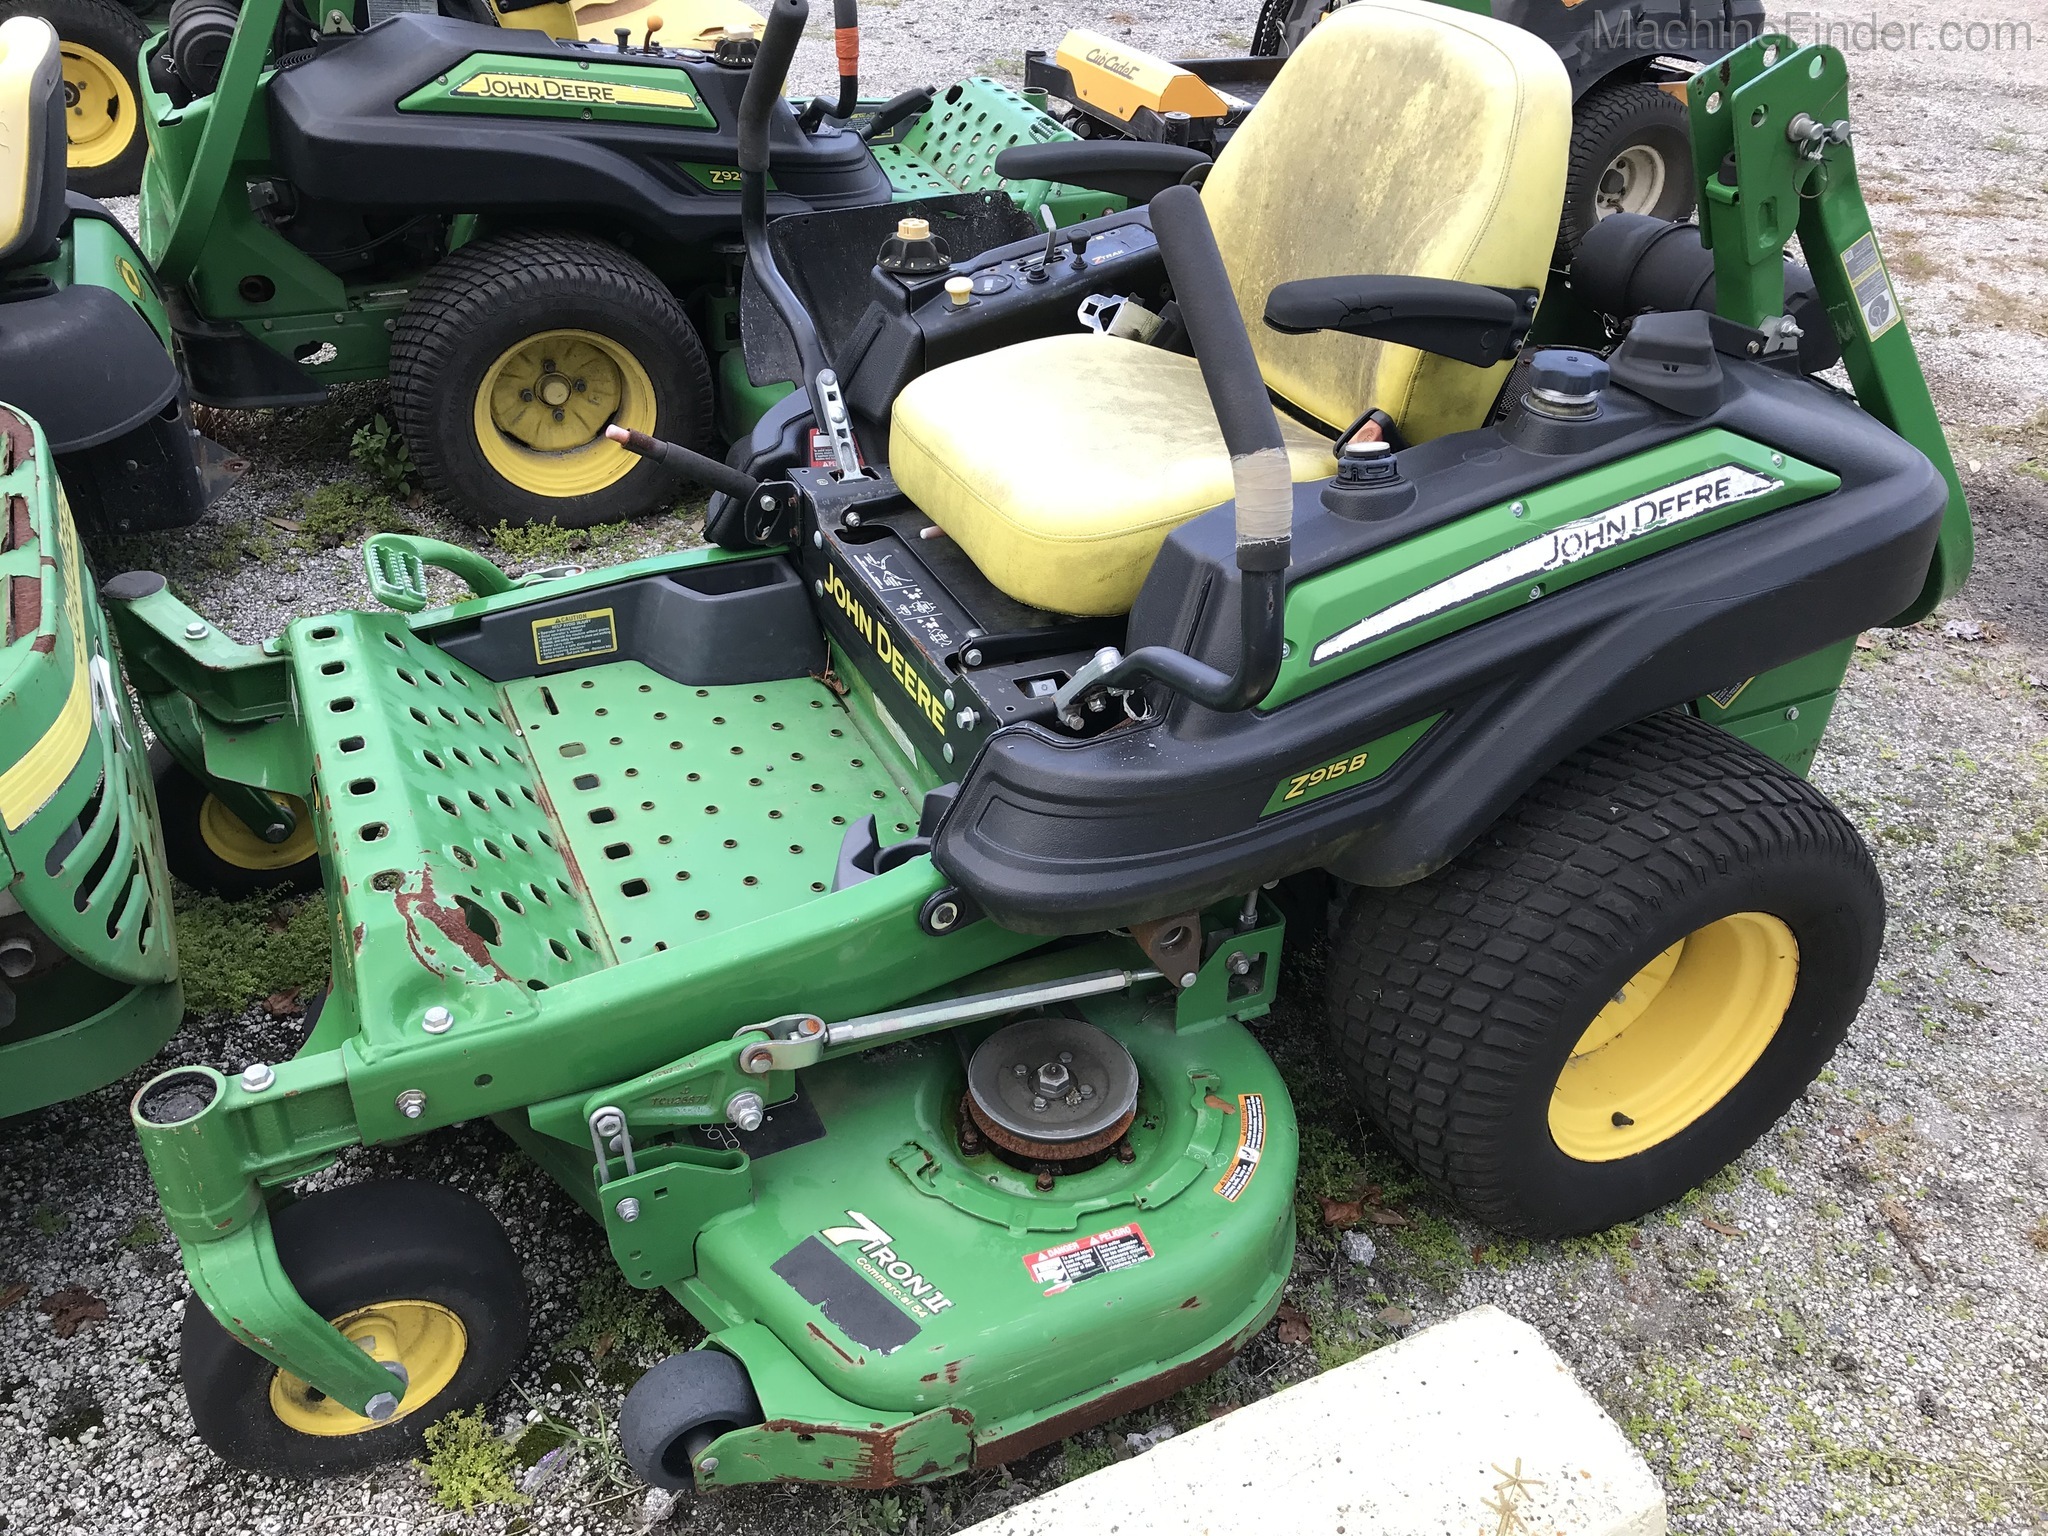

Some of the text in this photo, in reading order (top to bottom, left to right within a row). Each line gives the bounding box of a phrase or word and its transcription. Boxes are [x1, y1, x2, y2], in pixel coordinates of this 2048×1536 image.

[480, 76, 616, 101] JOHN DEERE
[709, 170, 743, 184] Z92
[1543, 515, 1626, 567] JOHN
[561, 613, 587, 622] CAUTION
[824, 563, 873, 645] JOHN
[876, 621, 946, 737] DEERE
[1283, 752, 1369, 801] Z915B
[1098, 1226, 1131, 1242] PELIGRO
[1047, 1242, 1079, 1257] DANGER
[855, 1257, 929, 1319] Commercial 54
